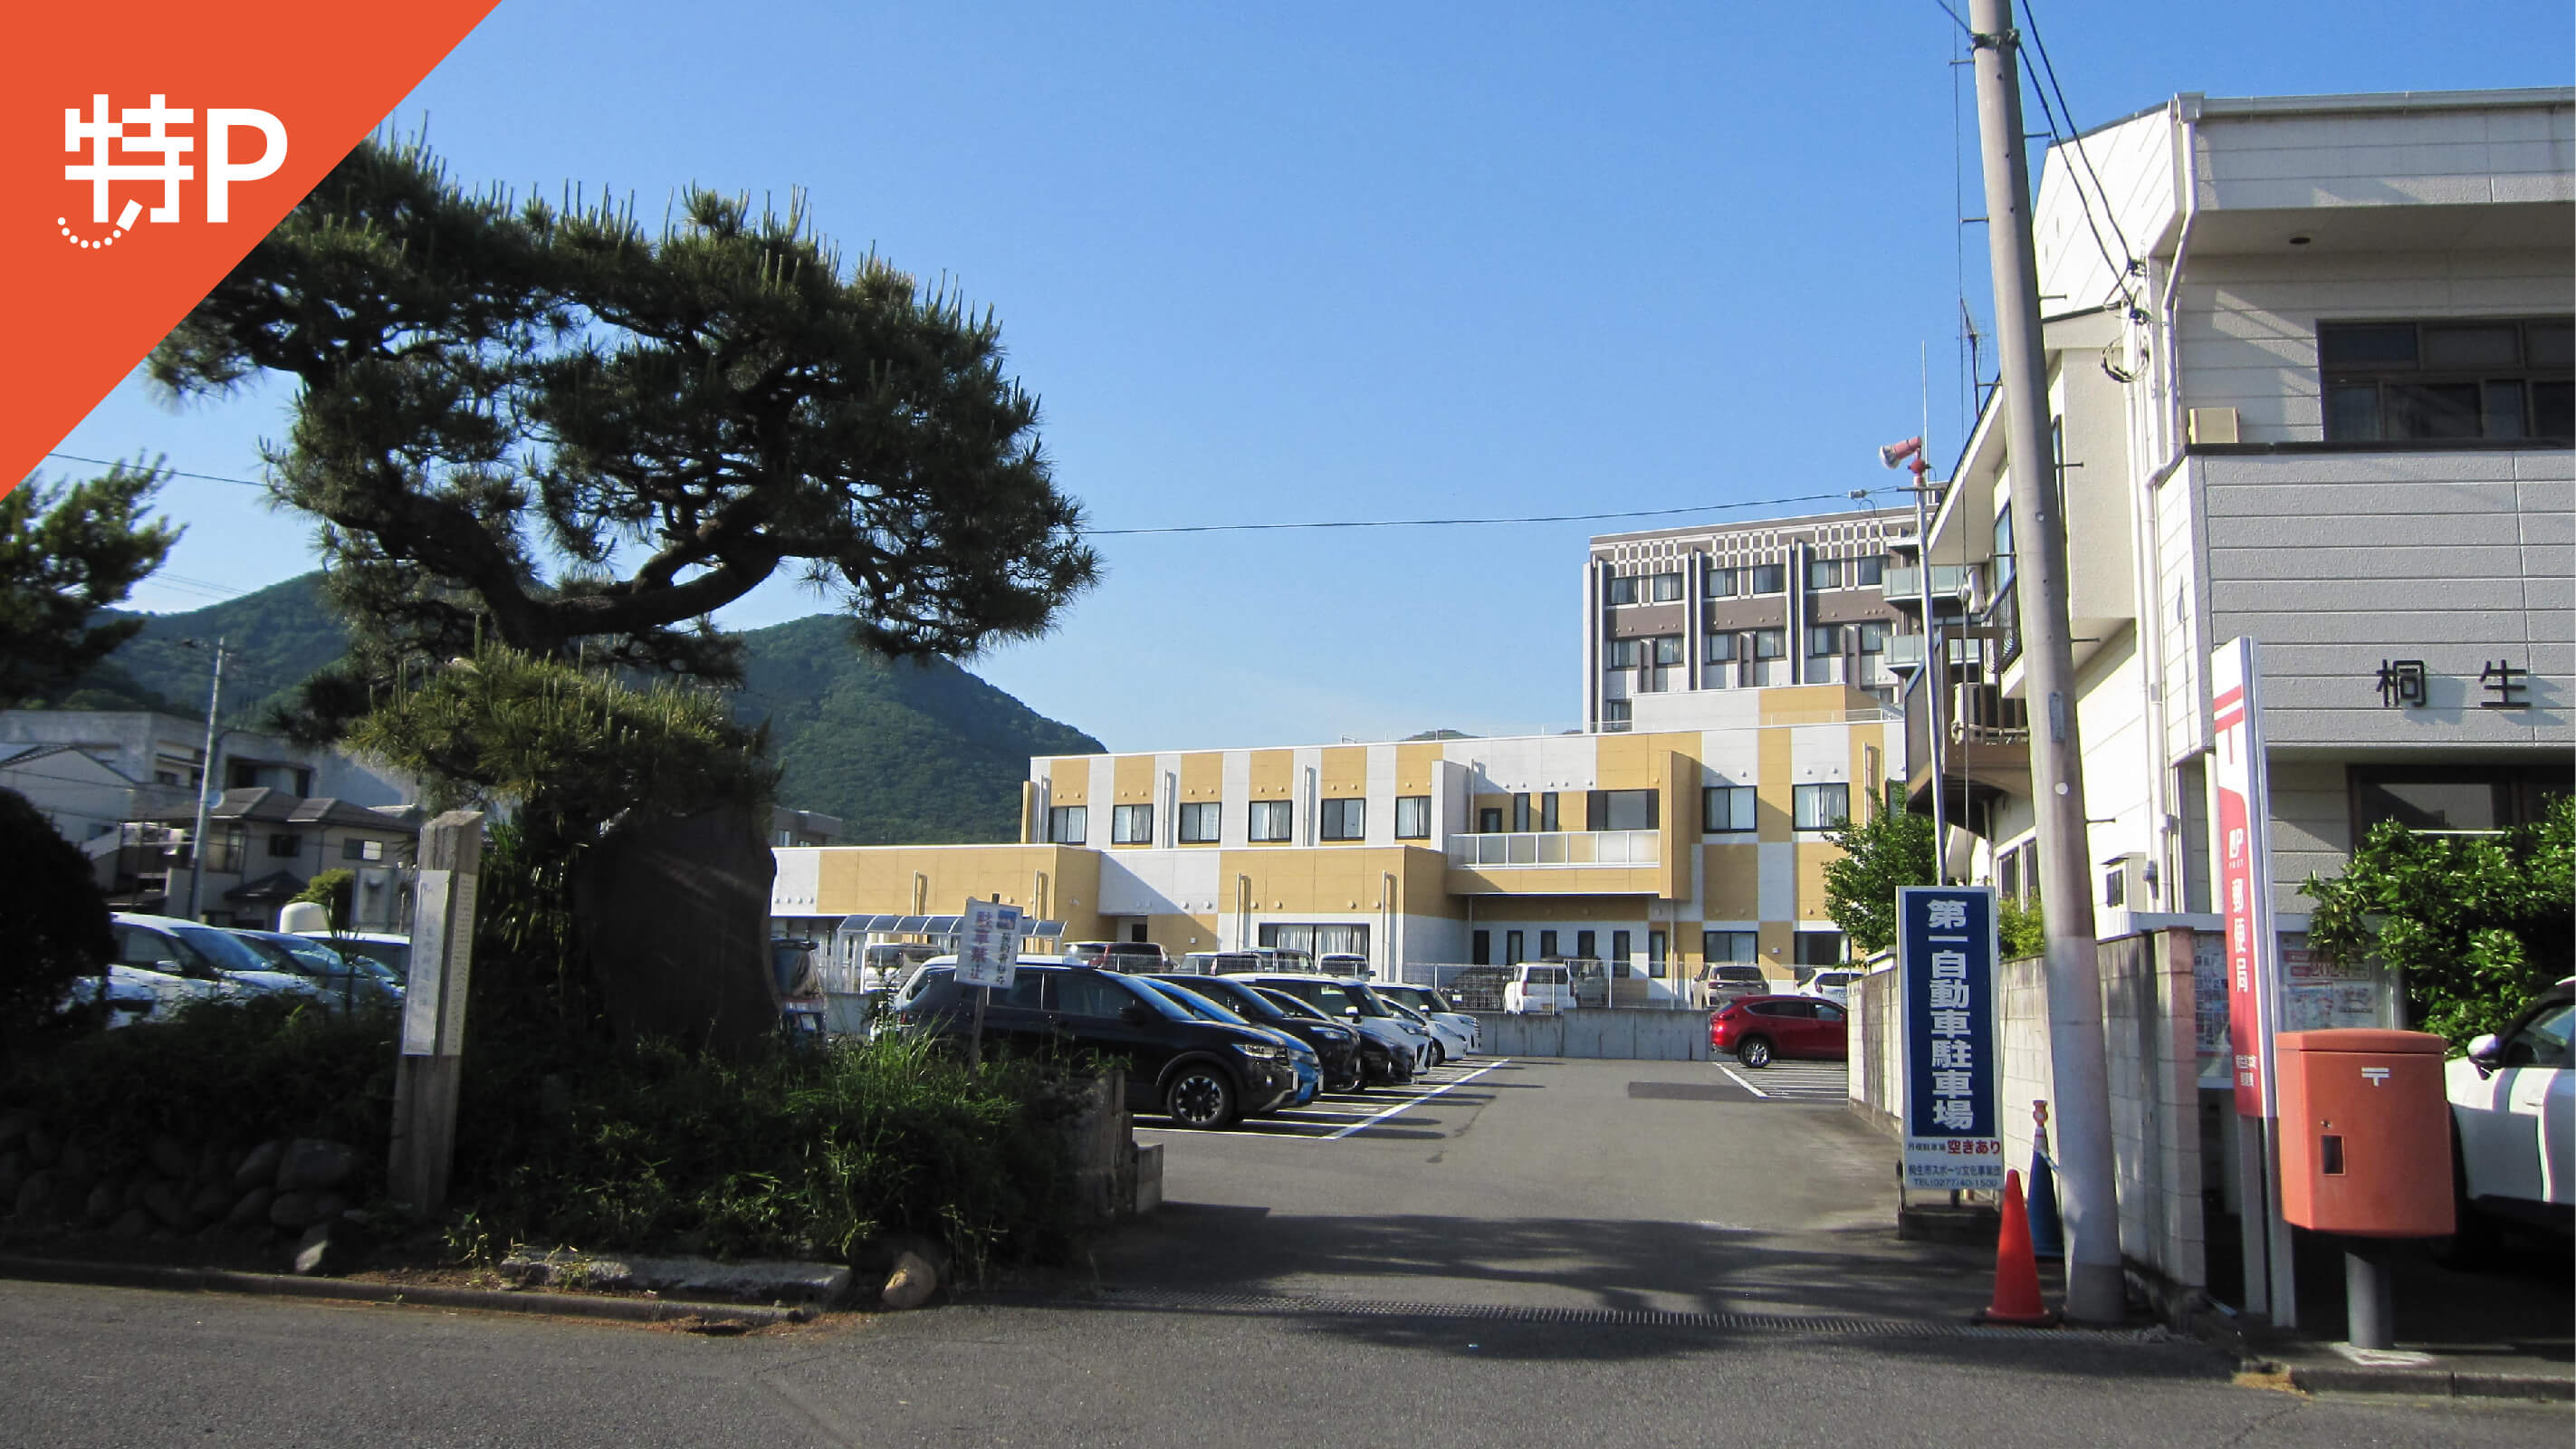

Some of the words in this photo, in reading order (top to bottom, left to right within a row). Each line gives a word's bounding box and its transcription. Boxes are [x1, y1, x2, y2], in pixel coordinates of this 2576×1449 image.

[2231, 878, 2249, 993] 郵便局
[1927, 898, 1976, 1131] 第一自動車駐車場
[1947, 1139, 2001, 1155] 空きあり
